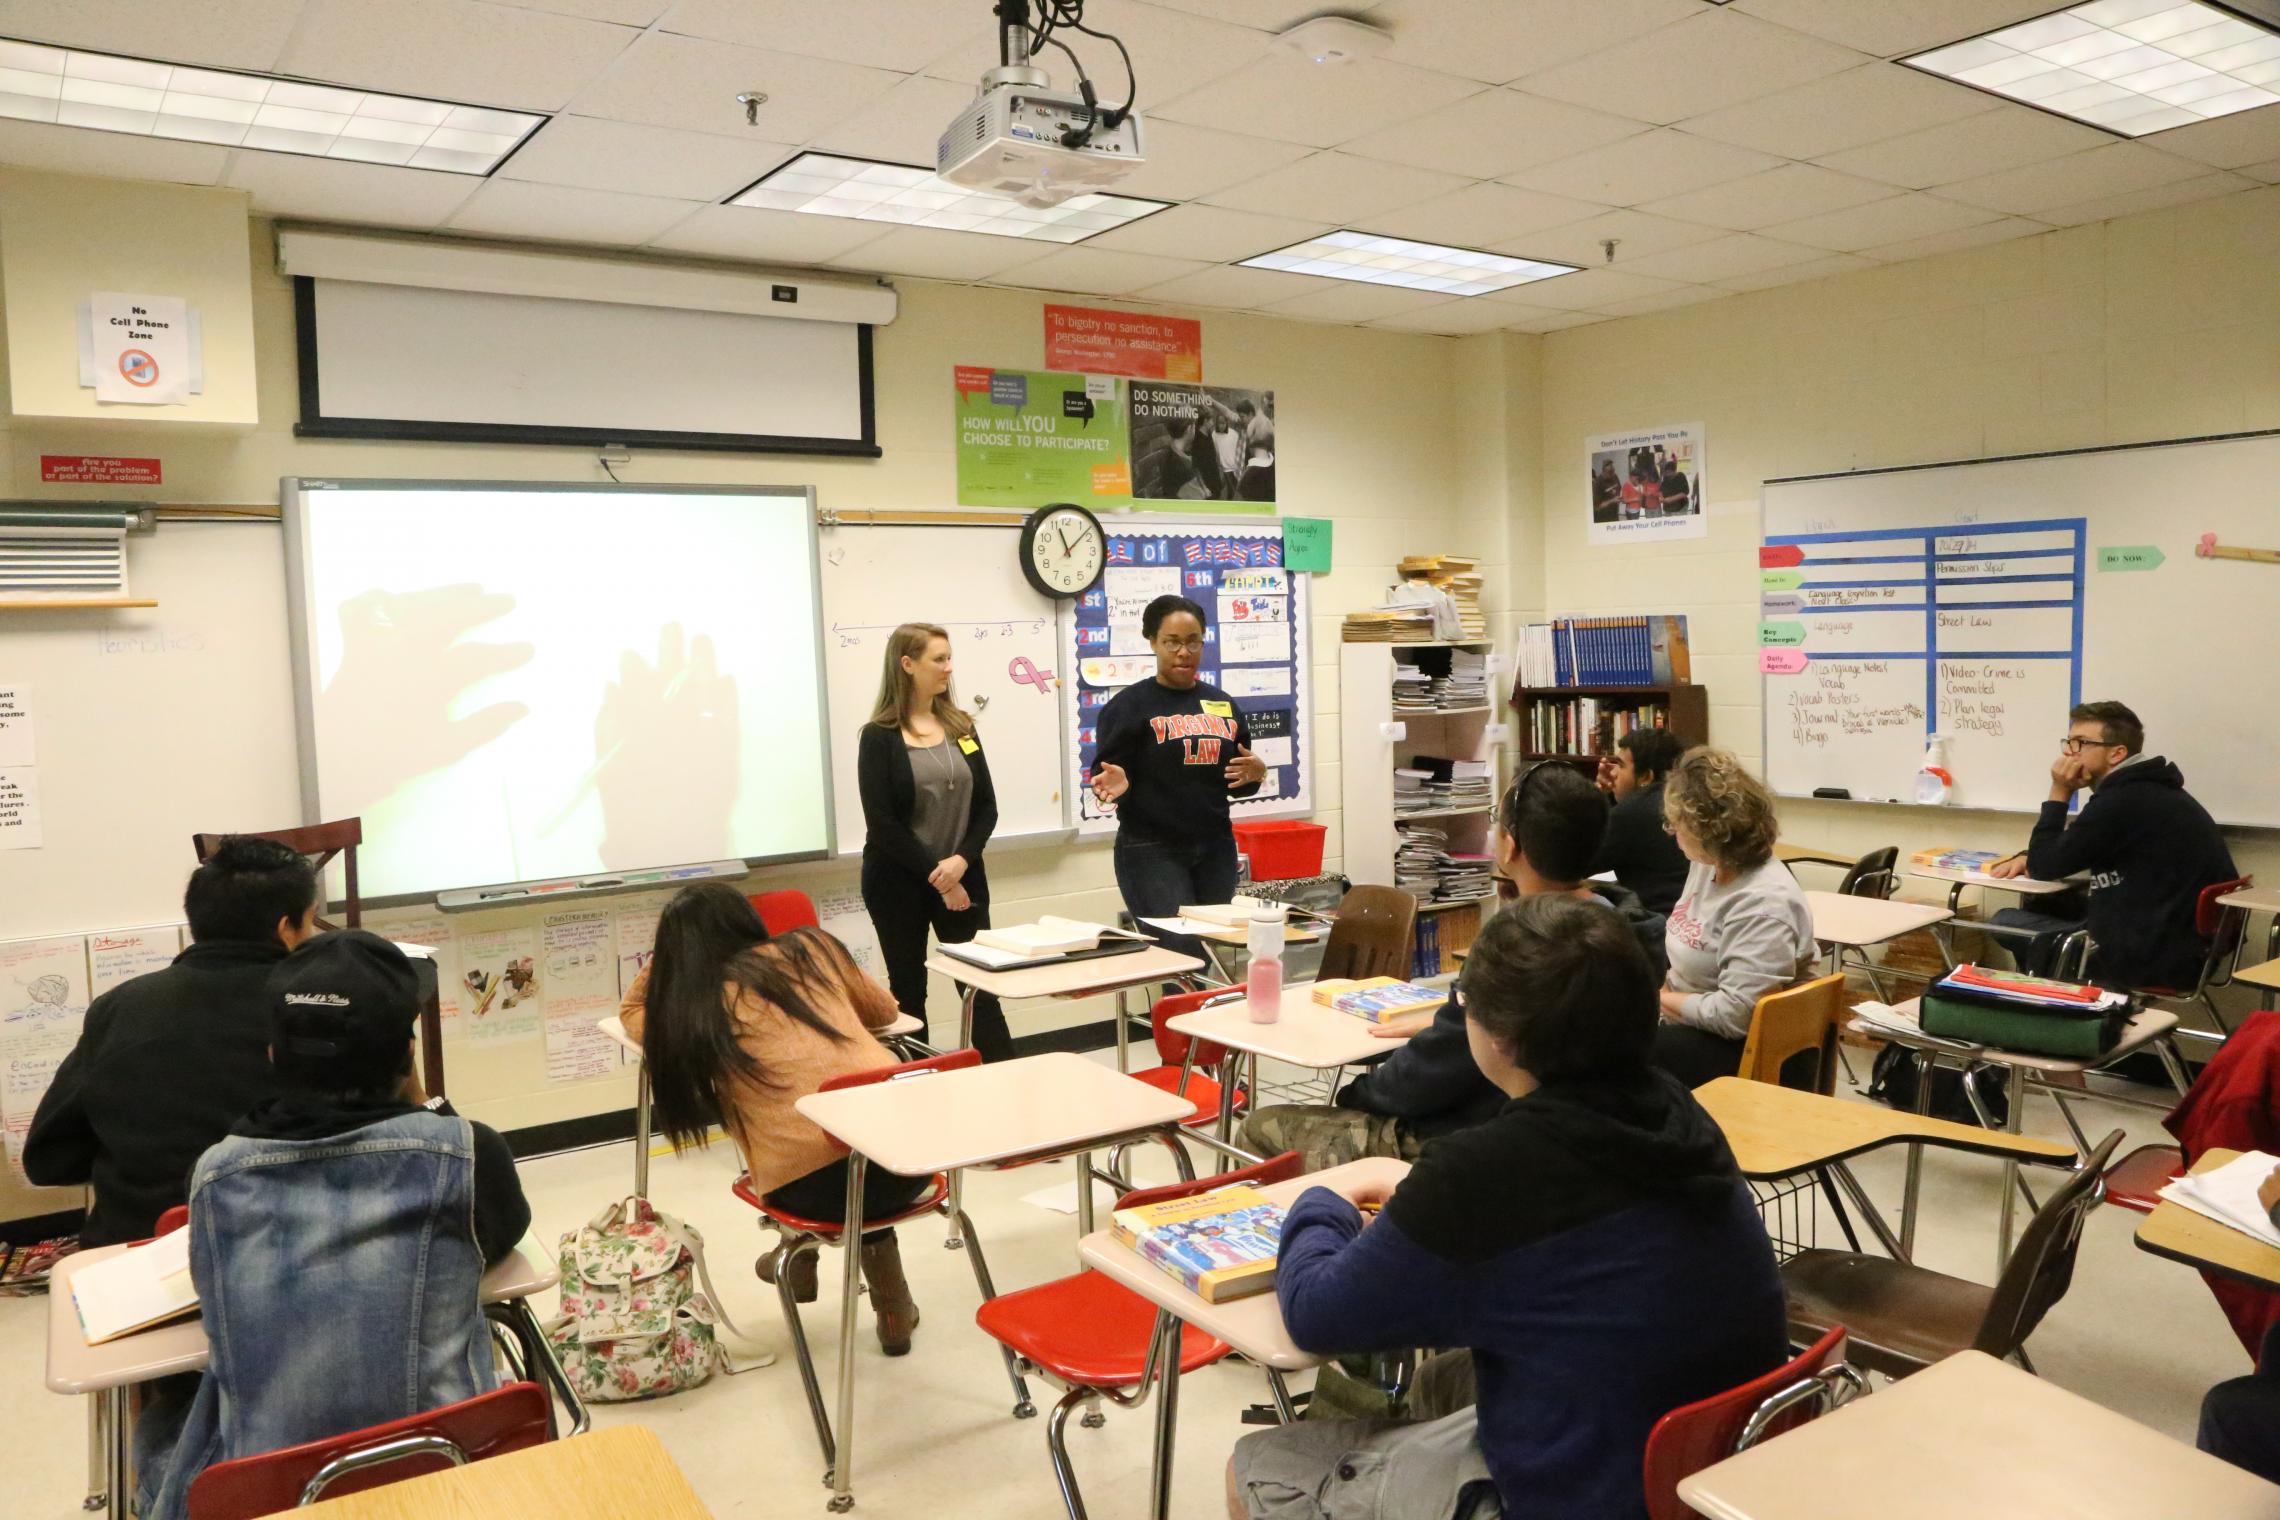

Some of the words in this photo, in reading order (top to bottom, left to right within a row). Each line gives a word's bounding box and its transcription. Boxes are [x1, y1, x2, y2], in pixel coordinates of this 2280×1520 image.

[132, 306, 147, 315] No
[110, 317, 131, 327] Cell
[136, 319, 170, 330] Phone
[1068, 315, 1101, 332] bigotry
[1104, 322, 1117, 332] no
[1119, 321, 1162, 338] sanction,
[1164, 327, 1173, 337] to
[128, 331, 153, 341] Zone
[1055, 331, 1111, 346] persecution
[1114, 338, 1127, 348] no
[1133, 389, 1149, 402] DO
[1152, 390, 1214, 407] SOMETHING
[1133, 403, 1149, 416] DO
[1152, 405, 1199, 420] NOTHING
[963, 416, 991, 430] HOW
[995, 418, 1022, 432] WILL
[1022, 415, 1056, 433] YOU
[963, 433, 1012, 447] CHOOSE
[1016, 435, 1030, 448] TO
[1035, 436, 1110, 452] PARTICIPATE?
[1601, 439, 1617, 448] Don't
[1629, 435, 1651, 446] History
[103, 460, 122, 468] you
[54, 466, 74, 474] part
[77, 466, 88, 474] of
[109, 467, 150, 476] problem
[59, 473, 80, 481] part
[82, 473, 93, 481] of
[115, 474, 159, 482] solution?
[1050, 520, 1058, 530] 11
[1061, 517, 1072, 526] 12
[1079, 520, 1083, 530] 1
[1040, 532, 1052, 543] 10
[1085, 532, 1093, 543] 2
[1037, 544, 1046, 555] 9
[1089, 546, 1097, 557] 3
[1143, 540, 1167, 561] of
[1184, 541, 1281, 566] RIGHTS
[1042, 558, 1050, 569] 8
[1086, 560, 1093, 569] 4
[2107, 555, 2119, 563] DO
[1936, 562, 1980, 574] Permission
[1053, 570, 1060, 580] 7
[1063, 575, 1071, 586] 6
[1076, 570, 1085, 581] 5
[1186, 571, 1213, 588] 6th
[1080, 591, 1102, 609] 1st
[1808, 589, 1843, 600] Language
[1814, 620, 1854, 635] Language
[1937, 616, 1965, 628] Street
[1970, 616, 1993, 628] Law
[1078, 627, 1108, 644] 2nd
[1766, 655, 1784, 664] Daily
[1819, 661, 1861, 680] Language
[1983, 665, 2013, 679] Crime
[2016, 668, 2025, 679] is
[1818, 677, 1846, 691] Vocab
[1946, 680, 1995, 695] Committed
[1082, 691, 1106, 707] 3rd
[1828, 692, 1860, 706] Posters
[1954, 698, 1975, 714] Plan
[1980, 701, 2005, 719] legal
[1272, 712, 1280, 720] is
[1954, 715, 2006, 737] strategy
[1183, 738, 1222, 765] LAW
[4, 819, 23, 827] and
